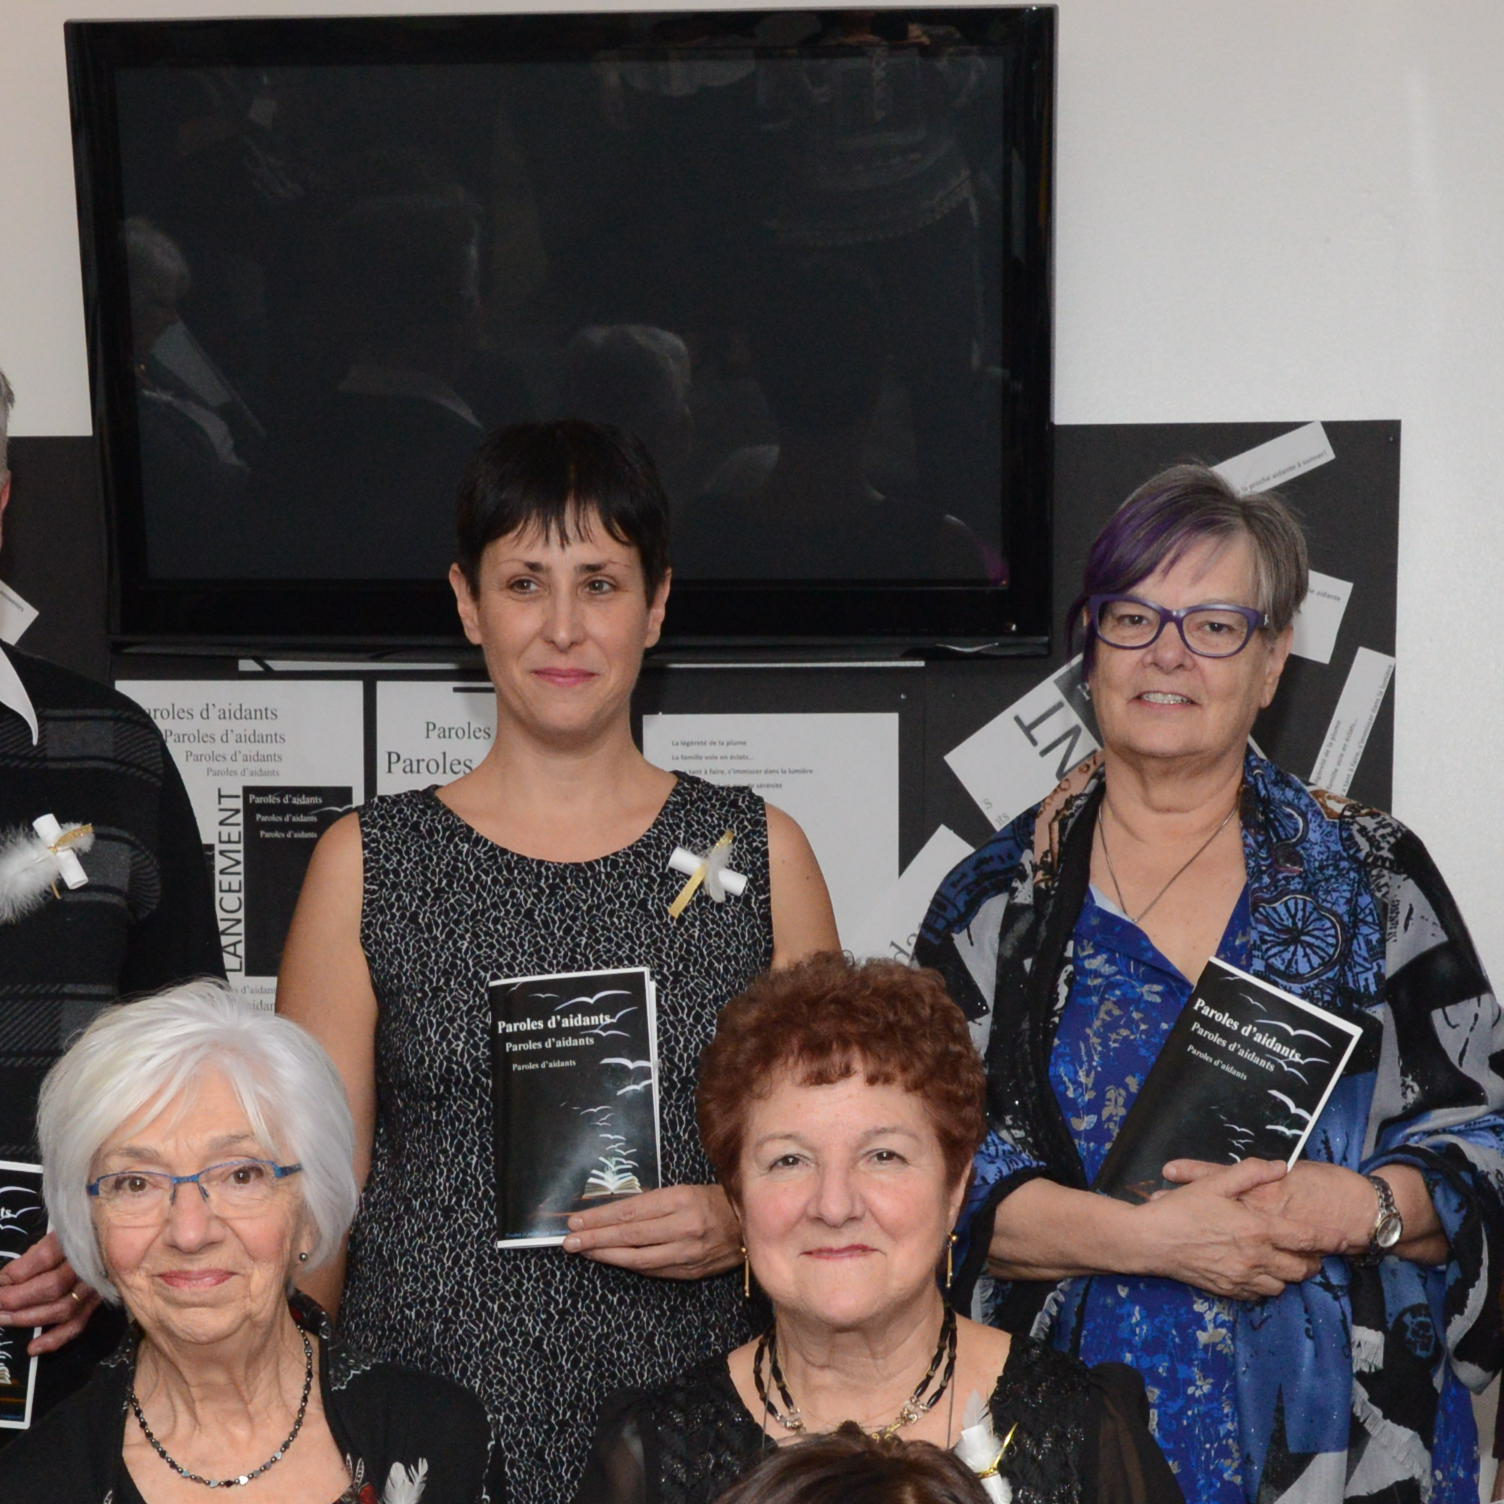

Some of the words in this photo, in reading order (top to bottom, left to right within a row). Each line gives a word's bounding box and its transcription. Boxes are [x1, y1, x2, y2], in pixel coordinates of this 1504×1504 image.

[200, 703, 278, 721] d'aidants
[164, 729, 216, 744] Paroles
[220, 729, 286, 744] d'aidants
[424, 721, 492, 740] Paroles
[185, 750, 227, 763] Paroles
[230, 750, 283, 763] d'aidants
[385, 751, 473, 775] Paroles
[206, 767, 238, 777] Paroles
[240, 767, 280, 777] d'aidants
[249, 794, 282, 804] Paroles
[283, 793, 323, 805] d'aidants
[218, 787, 243, 973] LANCEMENT
[498, 1017, 544, 1034] Paroles
[547, 1013, 611, 1029] d'aidants
[1193, 998, 1239, 1031] Paroles
[1241, 1024, 1302, 1061] d'aidants
[505, 1040, 542, 1053] Paroles
[545, 1036, 595, 1048] d'aidants
[1190, 1022, 1227, 1048] Paroles
[1228, 1042, 1276, 1073] d'aidants
[512, 1062, 539, 1072] Paroles
[540, 1059, 576, 1069] d'aidants
[1187, 1044, 1213, 1064] Paroles
[1213, 1058, 1248, 1081] d'aidants
